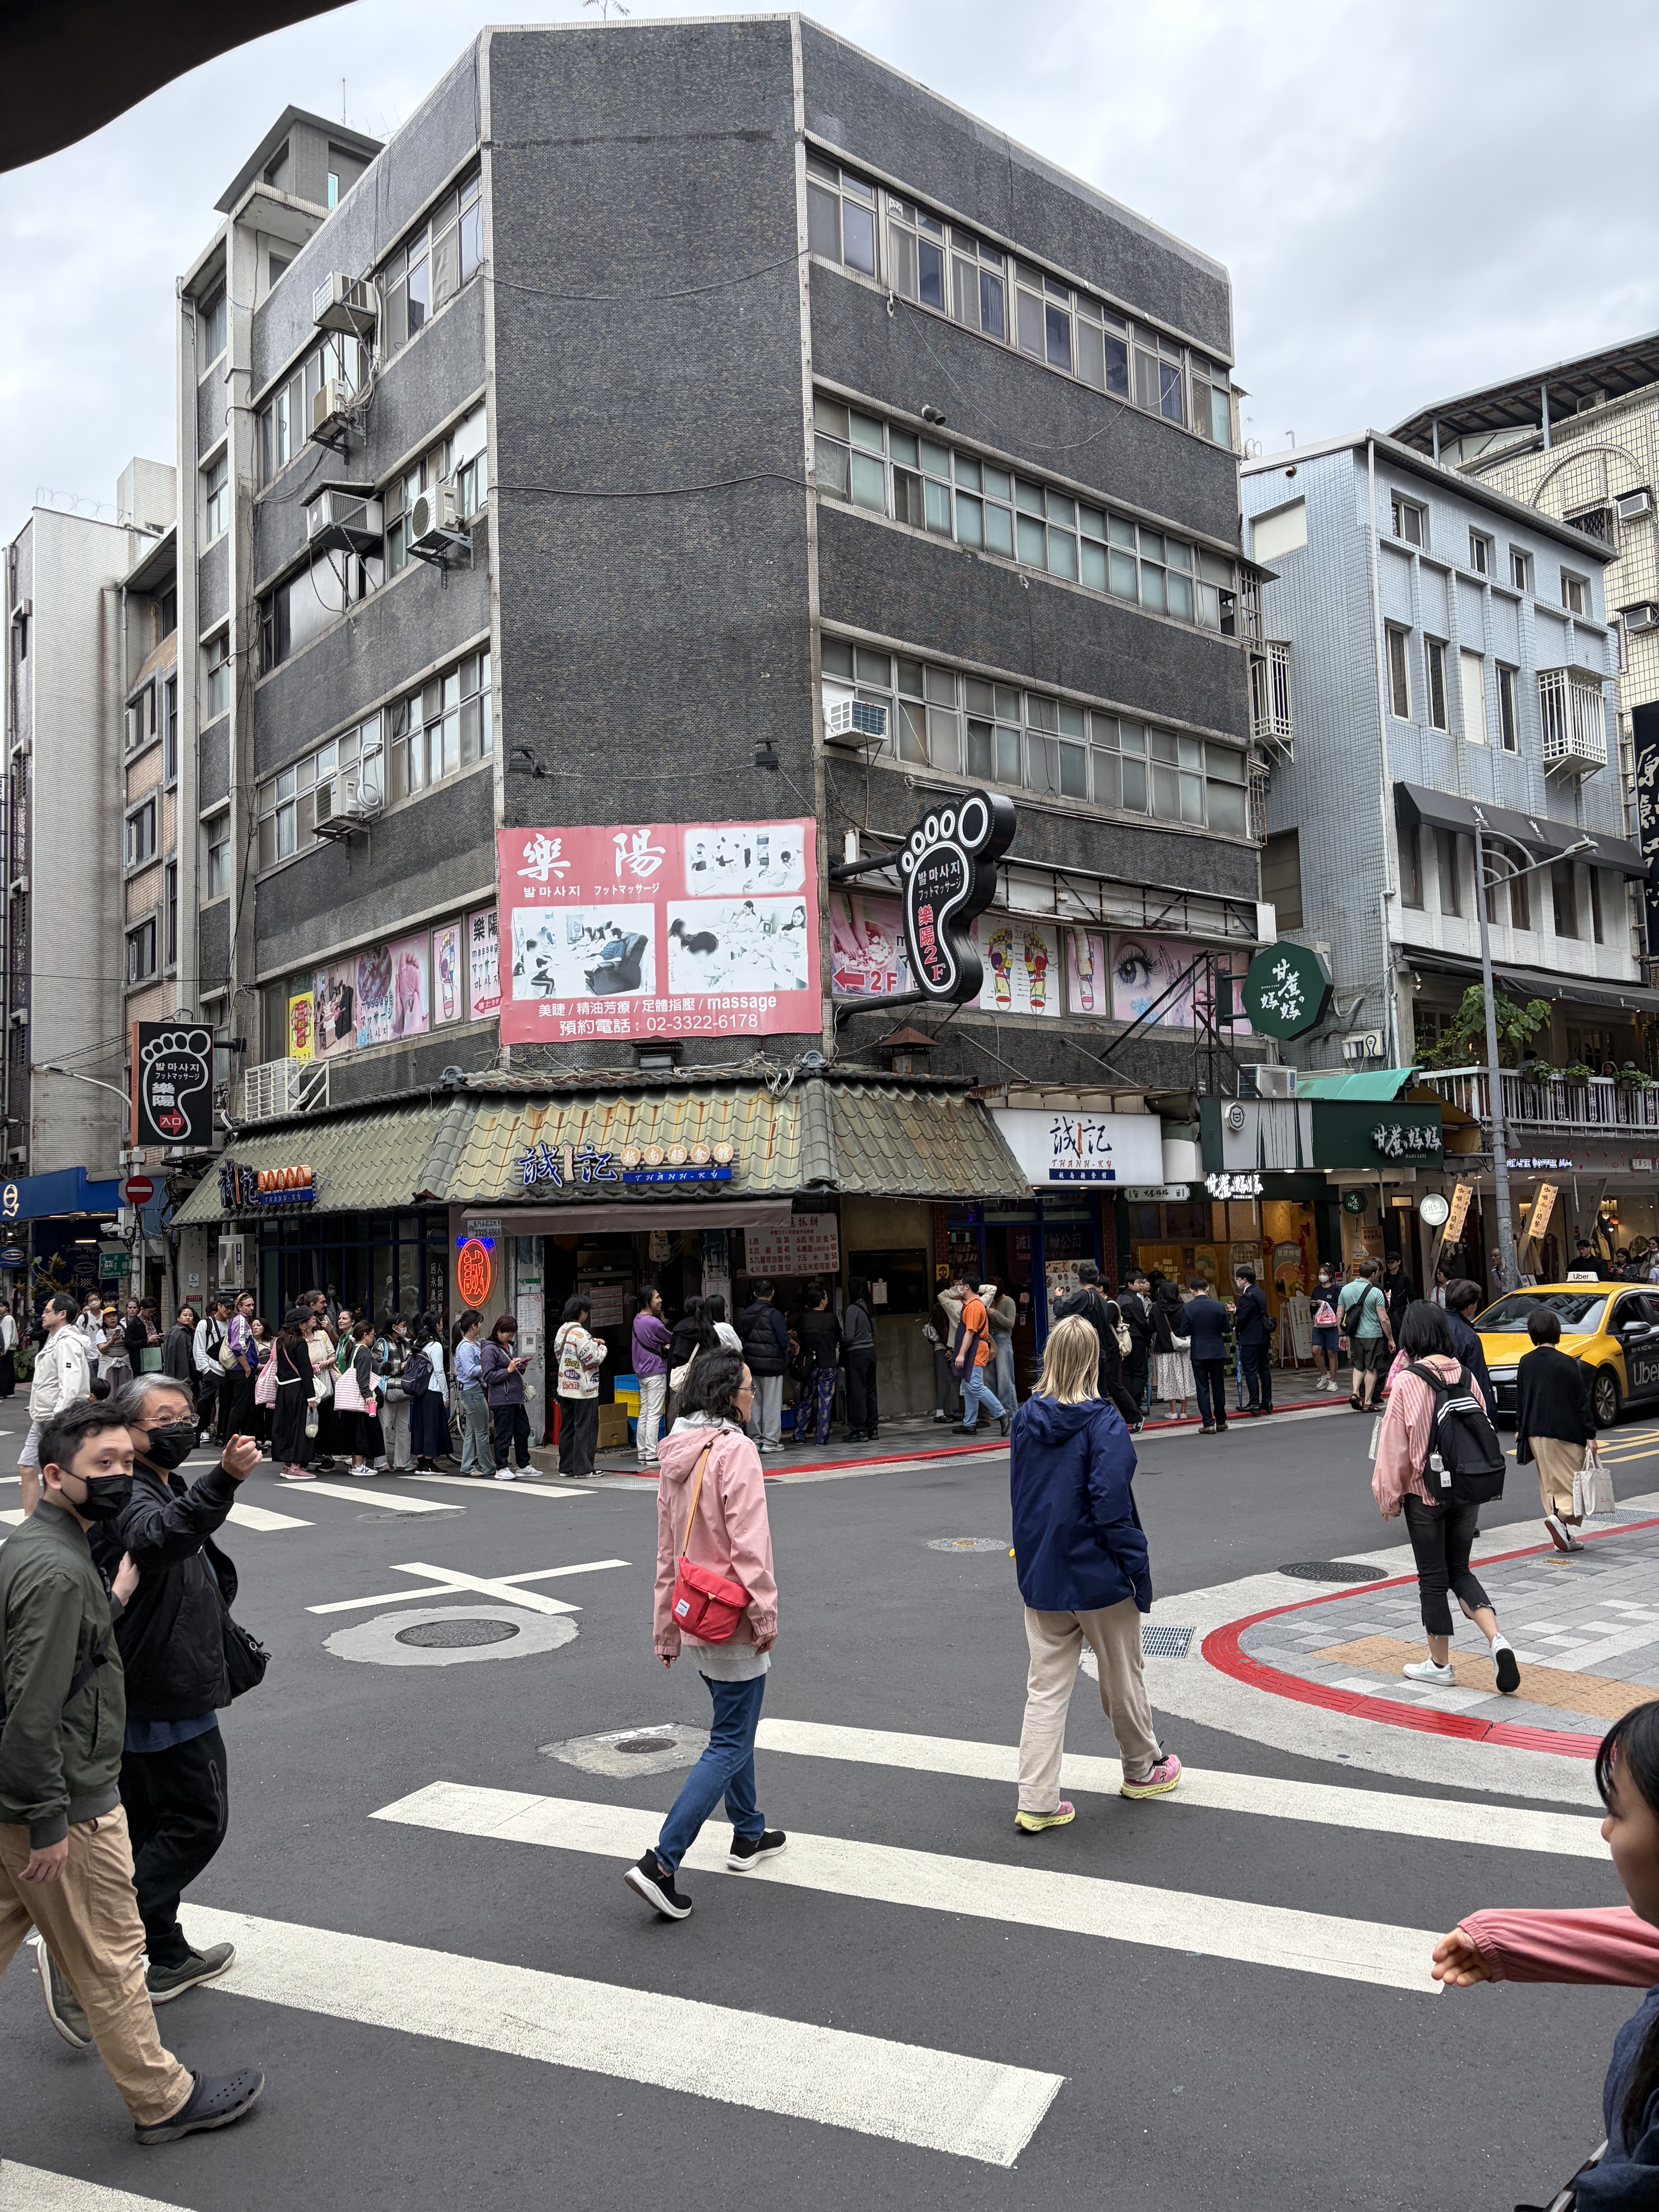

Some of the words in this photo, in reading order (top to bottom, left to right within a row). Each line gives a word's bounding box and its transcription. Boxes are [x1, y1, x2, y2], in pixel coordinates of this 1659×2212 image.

[517, 829, 666, 881] 樂陽
[594, 882, 659, 896] フットマッサージ
[472, 943, 498, 958] massag
[472, 958, 496, 973] マッサー
[870, 970, 897, 992] 2F
[361, 993, 393, 1011] massage
[538, 1003, 566, 1017] 美睫
[577, 1001, 630, 1015] 精油芳療
[642, 998, 696, 1012] 足體指壓
[707, 995, 776, 1012] massage
[361, 1006, 393, 1026] マッサージ
[647, 1014, 758, 1031] 02-3322-6178
[367, 1024, 388, 1042] 마사지
[152, 1082, 175, 1106] 樂陽
[623, 1146, 730, 1164] 越南麵食館
[463, 1250, 484, 1296] 誠
